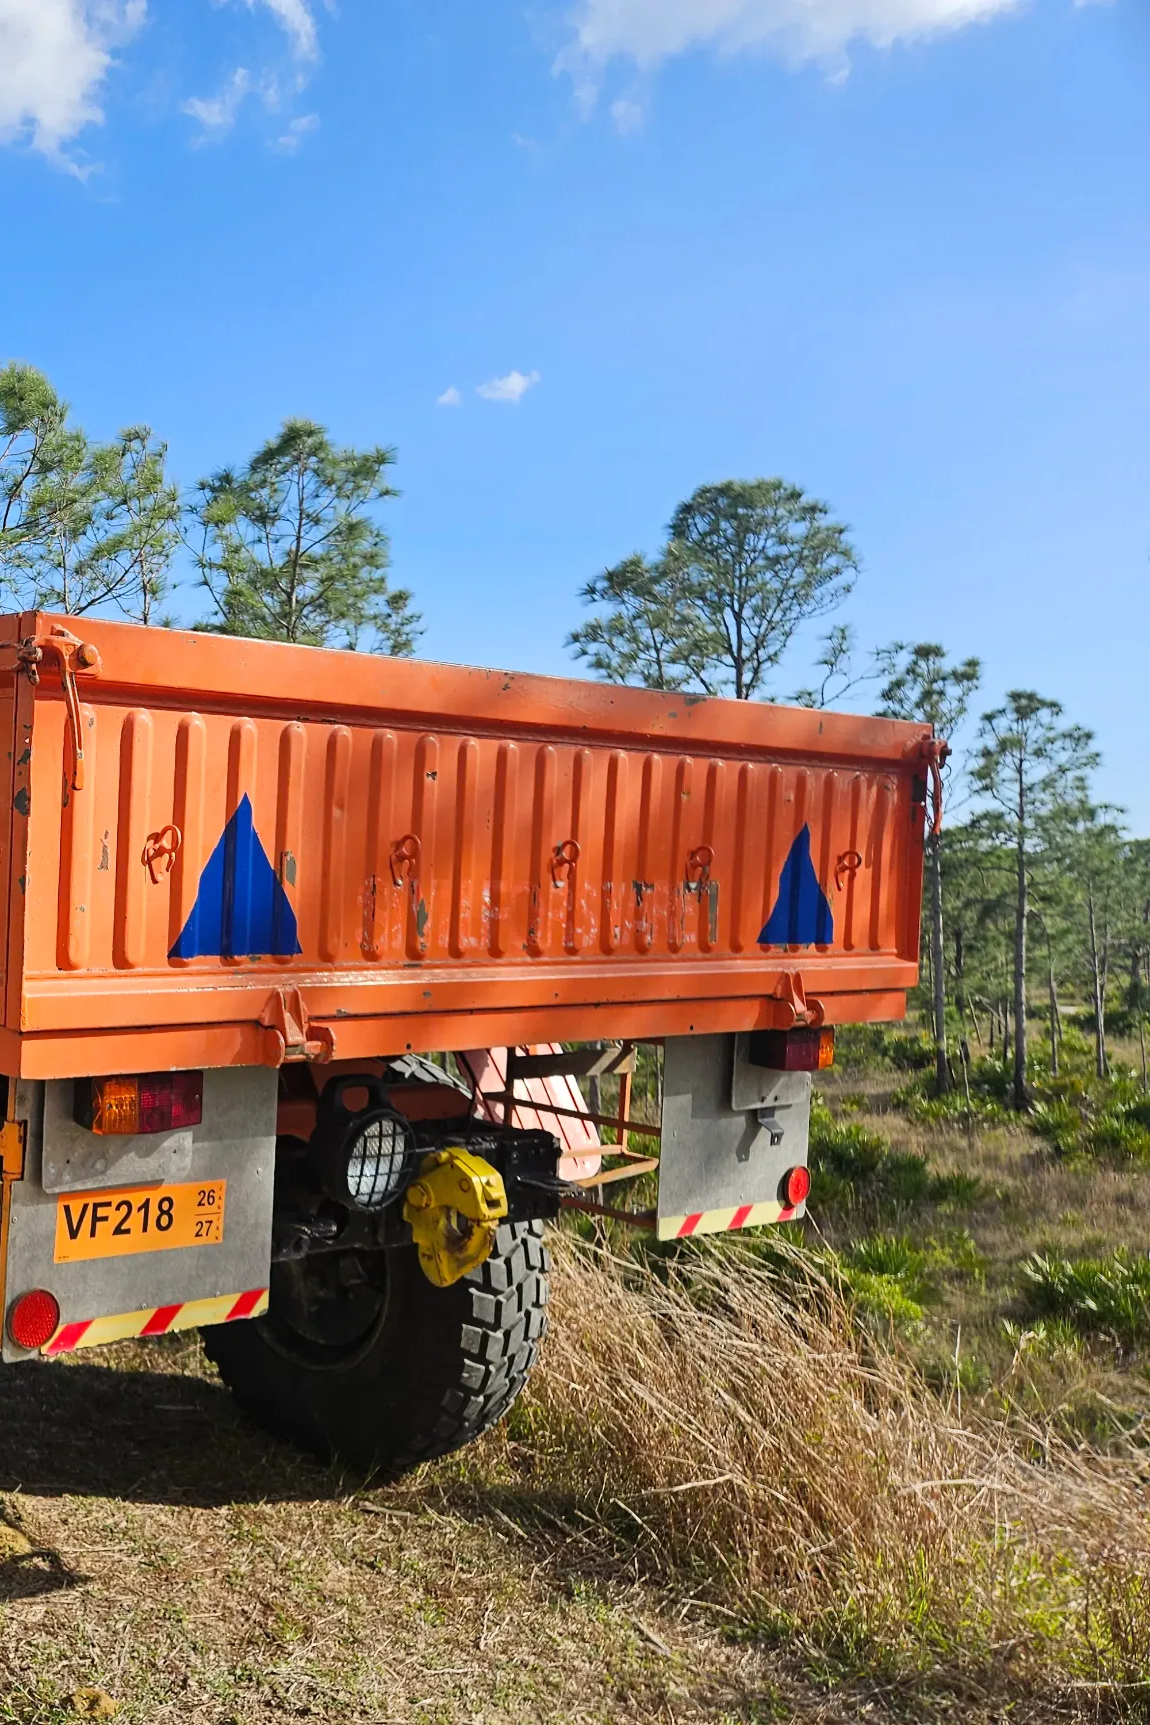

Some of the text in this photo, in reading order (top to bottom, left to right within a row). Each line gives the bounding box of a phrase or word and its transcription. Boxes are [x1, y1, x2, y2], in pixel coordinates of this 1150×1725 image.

[197, 1188, 216, 1207] 26
[62, 1196, 174, 1241] VF218
[194, 1219, 214, 1238] 27
